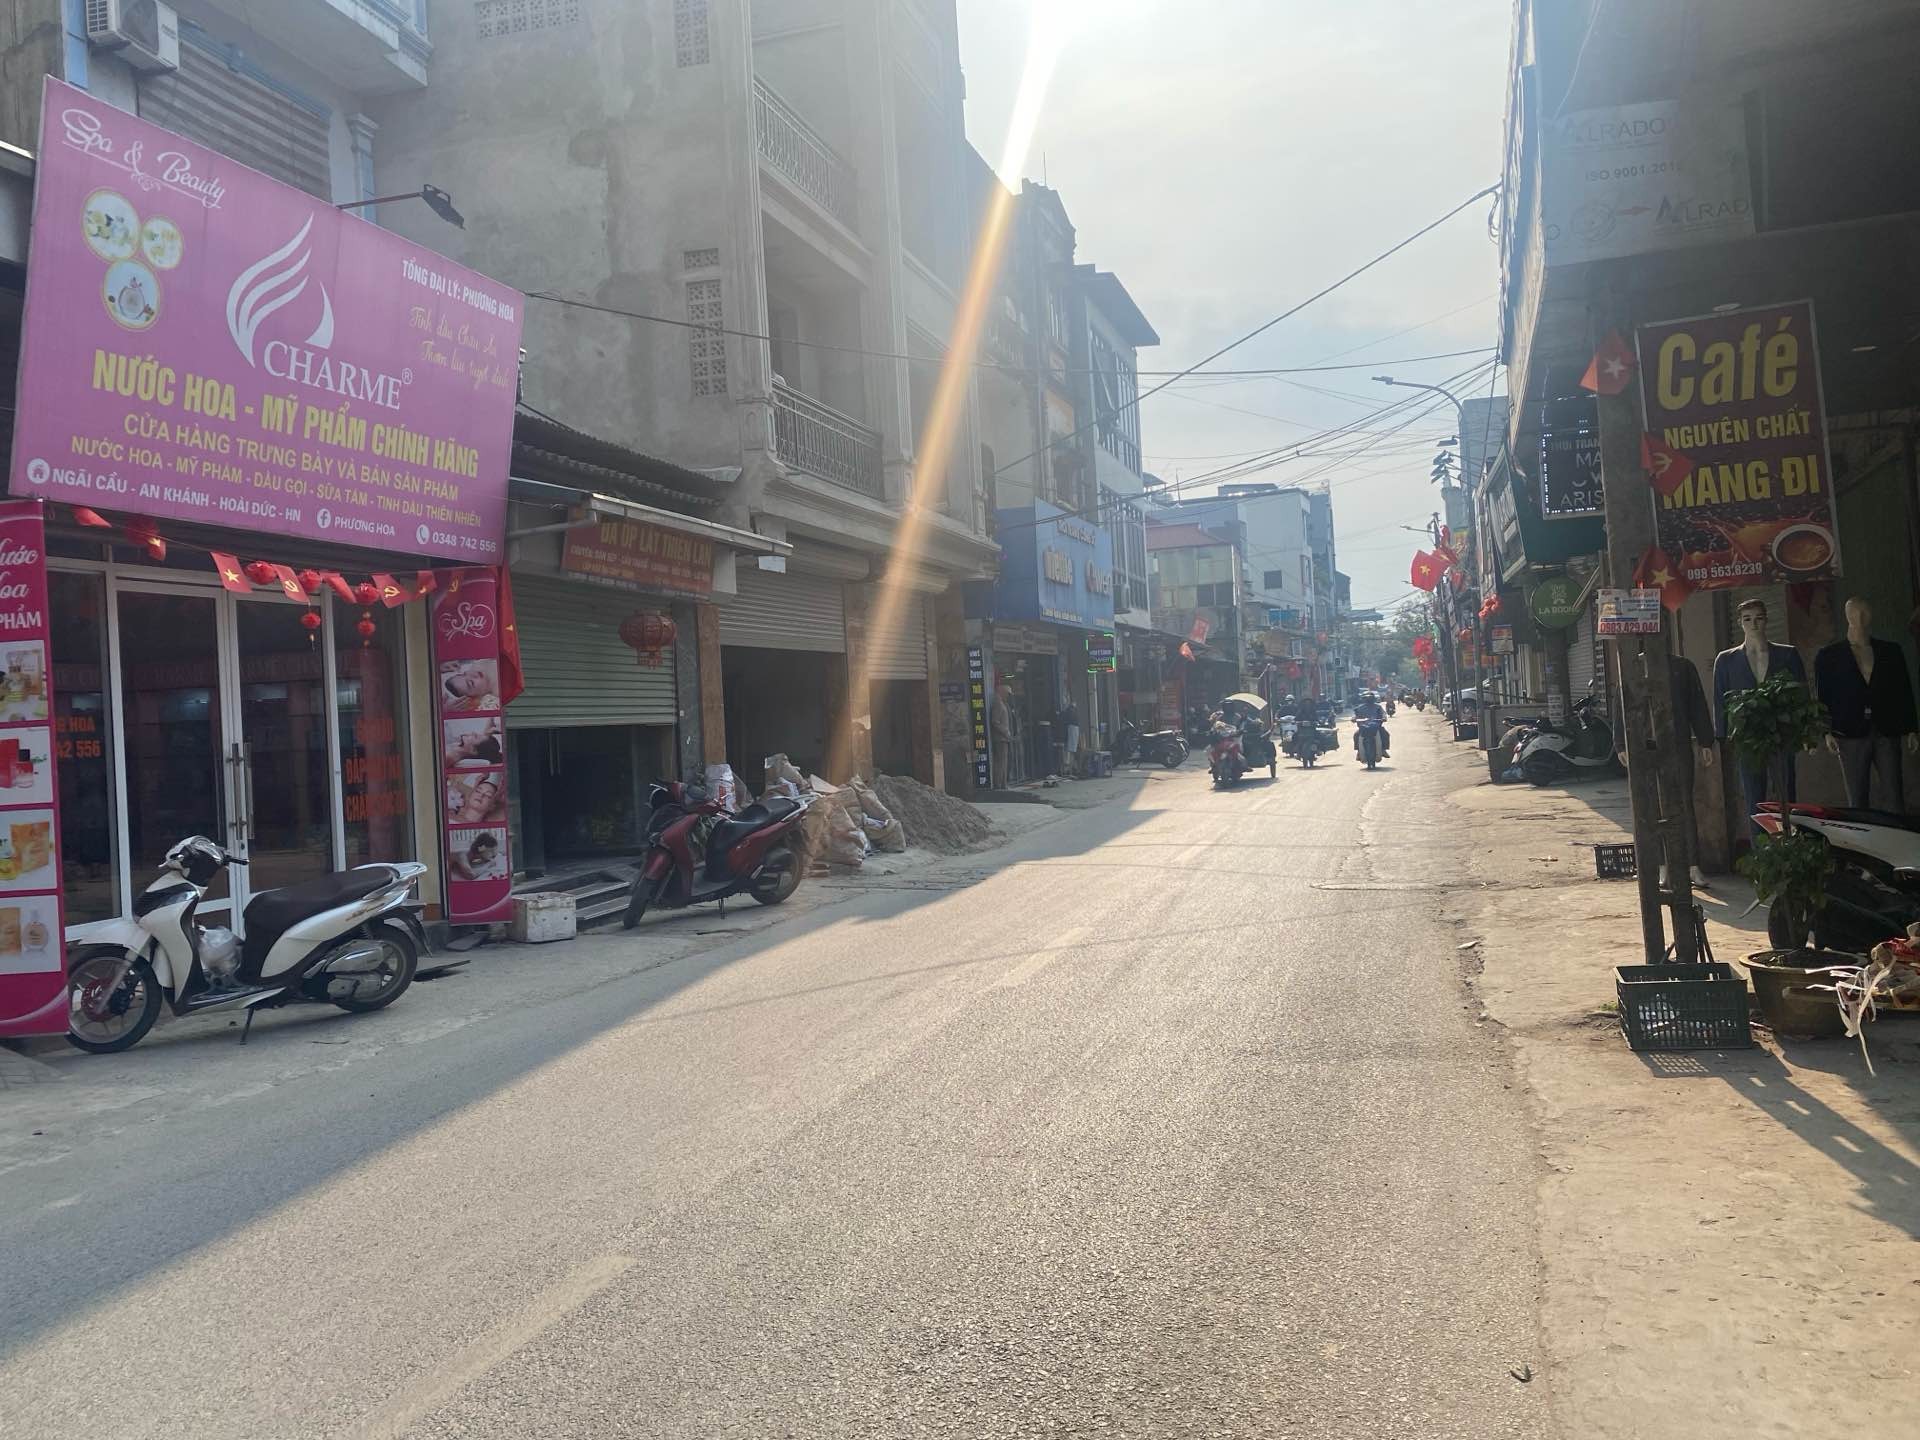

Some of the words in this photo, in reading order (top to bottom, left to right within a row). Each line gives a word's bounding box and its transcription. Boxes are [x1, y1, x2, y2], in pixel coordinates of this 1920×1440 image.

[62, 109, 112, 152] Spa
[124, 141, 144, 175] &
[157, 152, 225, 208] Beauty
[402, 257, 428, 286] TỔNG
[430, 272, 445, 295] ĐẠI
[462, 286, 498, 315] PHƯƠNG
[498, 302, 514, 322] HOA
[263, 340, 400, 410] CHARME
[1658, 315, 1798, 410] Café
[93, 348, 176, 406] NƯỚC
[184, 373, 236, 421] HOA
[244, 405, 254, 415] -
[261, 394, 298, 435] MỸ
[304, 401, 367, 451] PHẨM
[371, 423, 430, 467] CHÍNH
[433, 437, 479, 478] HÃNG
[1664, 416, 1749, 450] NGUYÊN
[1756, 404, 1811, 440] CHẤT
[71, 436, 124, 461] NƯỚC
[128, 447, 163, 470] HOA
[176, 455, 198, 475] MỸ
[124, 412, 171, 442] CỬA
[235, 438, 297, 468] TRƯNG
[337, 460, 356, 481] VÀ
[52, 467, 91, 488] NGÃI
[95, 472, 128, 493] CẦU
[139, 482, 160, 499] AN
[163, 487, 209, 508] KHÁNH
[219, 495, 249, 514] HOÀI
[251, 500, 276, 517] ĐỨC
[285, 508, 301, 522] HN
[1781, 455, 1820, 497] ĐI
[334, 515, 375, 534] PHƯƠNG
[376, 522, 395, 538] HOA
[432, 532, 457, 547] 0348
[459, 536, 478, 550] 742
[479, 540, 497, 553] 556
[0, 537, 38, 566] ước
[0, 571, 29, 599] oa
[451, 602, 488, 635] Spa
[76, 740, 102, 759] 556
